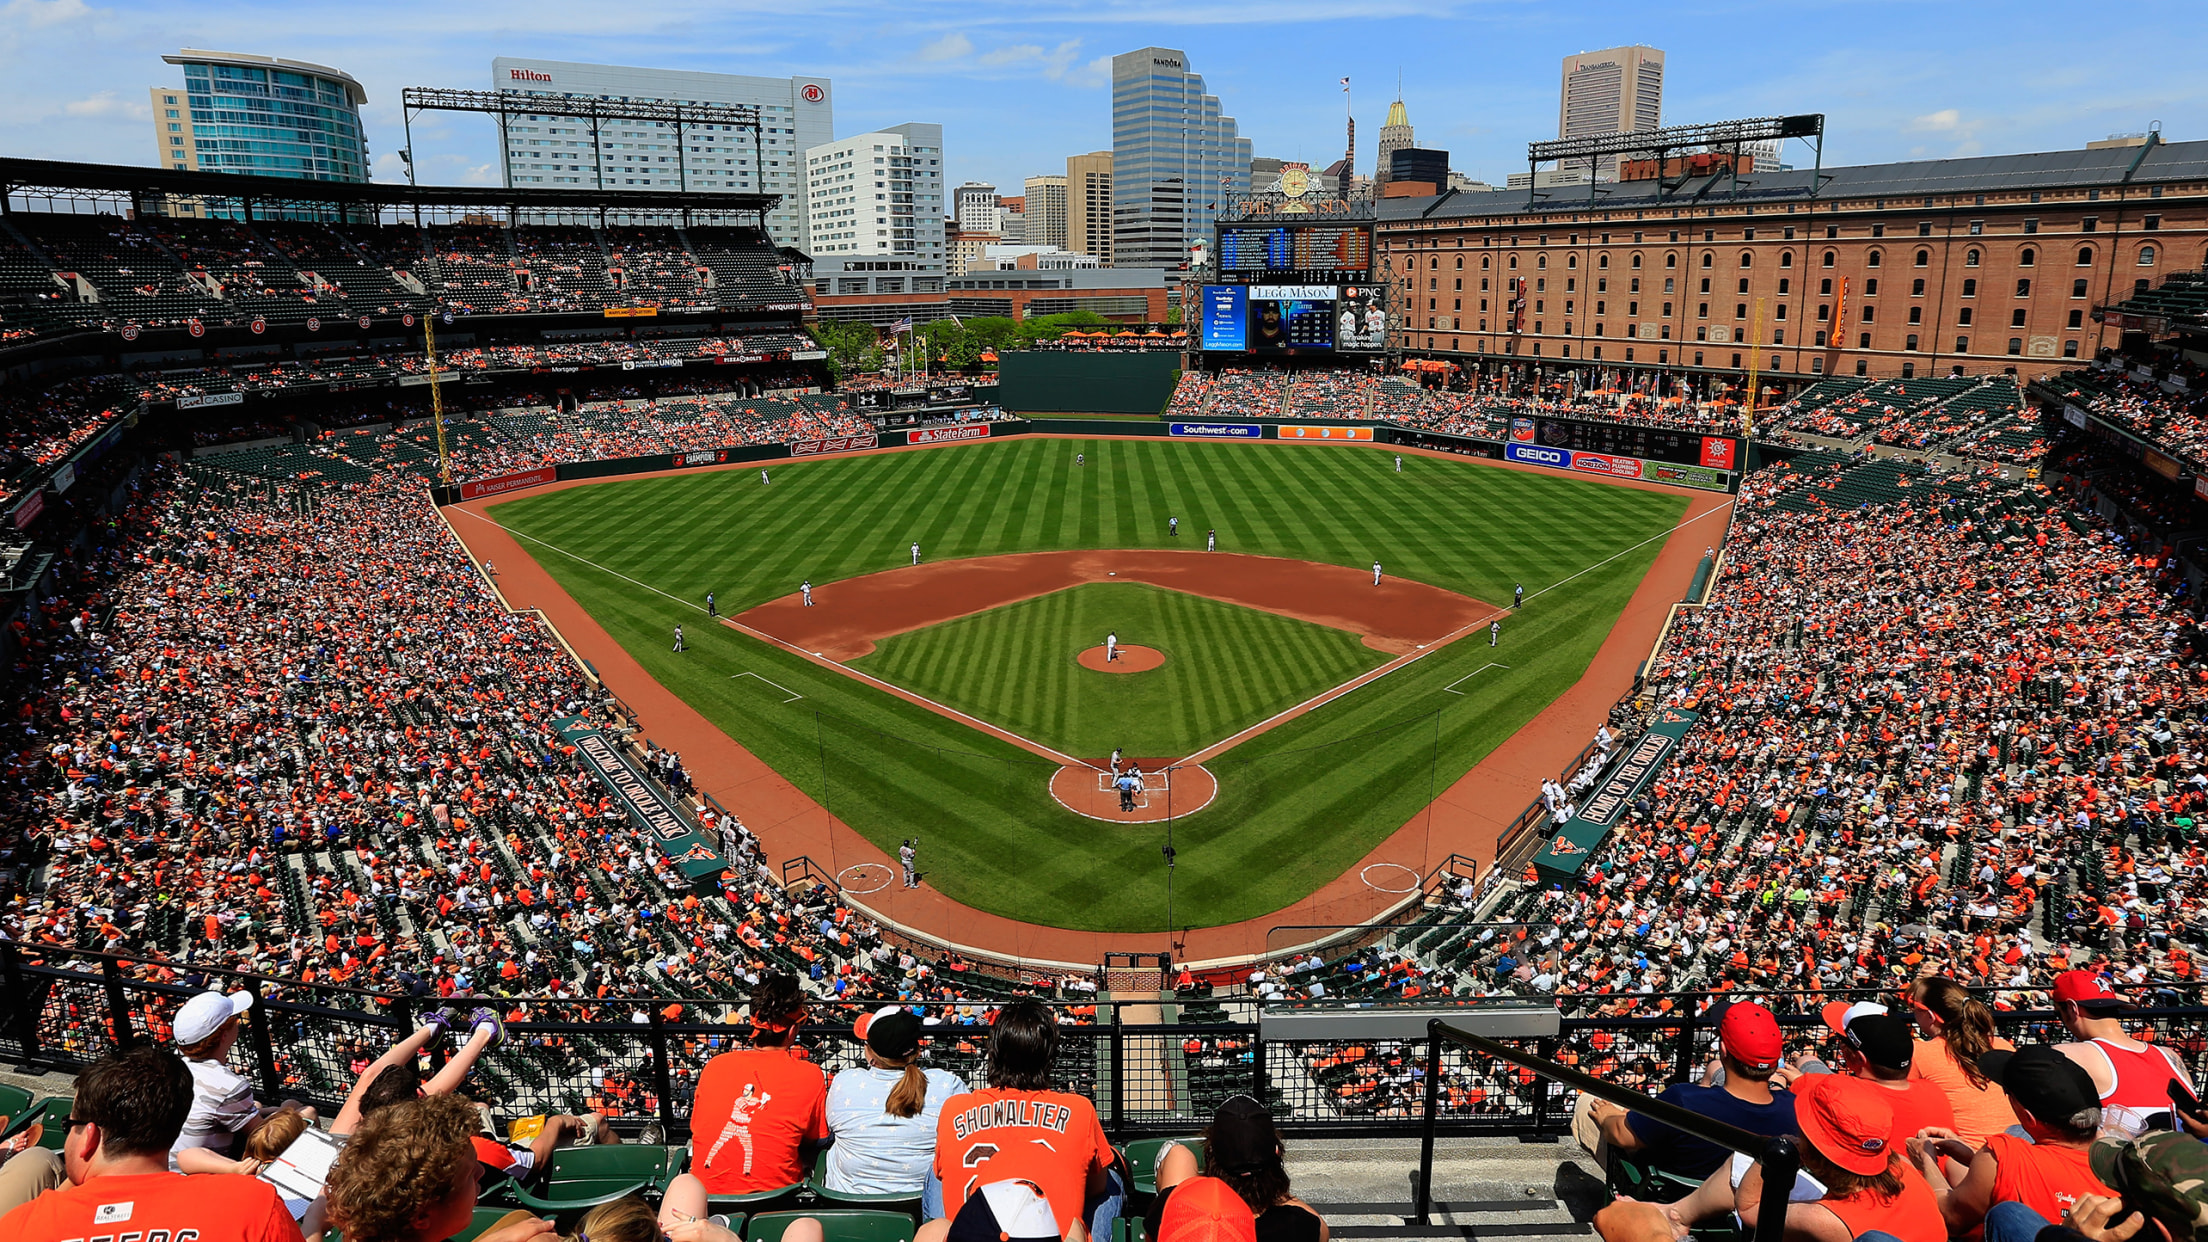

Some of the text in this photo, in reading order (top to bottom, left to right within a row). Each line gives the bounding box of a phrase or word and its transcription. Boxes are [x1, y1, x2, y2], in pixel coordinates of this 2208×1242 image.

[1153, 57, 1182, 68] PANDORA
[511, 69, 551, 82] Hilton
[1279, 162, 1311, 174] ORIOLES
[1239, 200, 1350, 215] THE SUN
[1258, 288, 1328, 298] LEGG MASON
[1358, 288, 1381, 297] PNC
[770, 303, 798, 311] NYQUIST
[309, 320, 319, 329] 22
[124, 328, 136, 338] 20
[660, 358, 683, 367] UNION
[552, 366, 579, 374] Mortgage
[204, 394, 242, 405] CASINO
[1183, 426, 1248, 436] Southwest.com
[686, 453, 716, 464] CHAMPIONS
[1516, 448, 1560, 463] GEICO
[1577, 460, 1610, 471] HORIZON
[486, 484, 506, 492] KAISER
[1582, 736, 1668, 823] HOME OF THE ORIOLES
[580, 737, 685, 839] WELCOME TO ORIOLE PARK
[953, 1100, 1072, 1141] SHOWALTER
